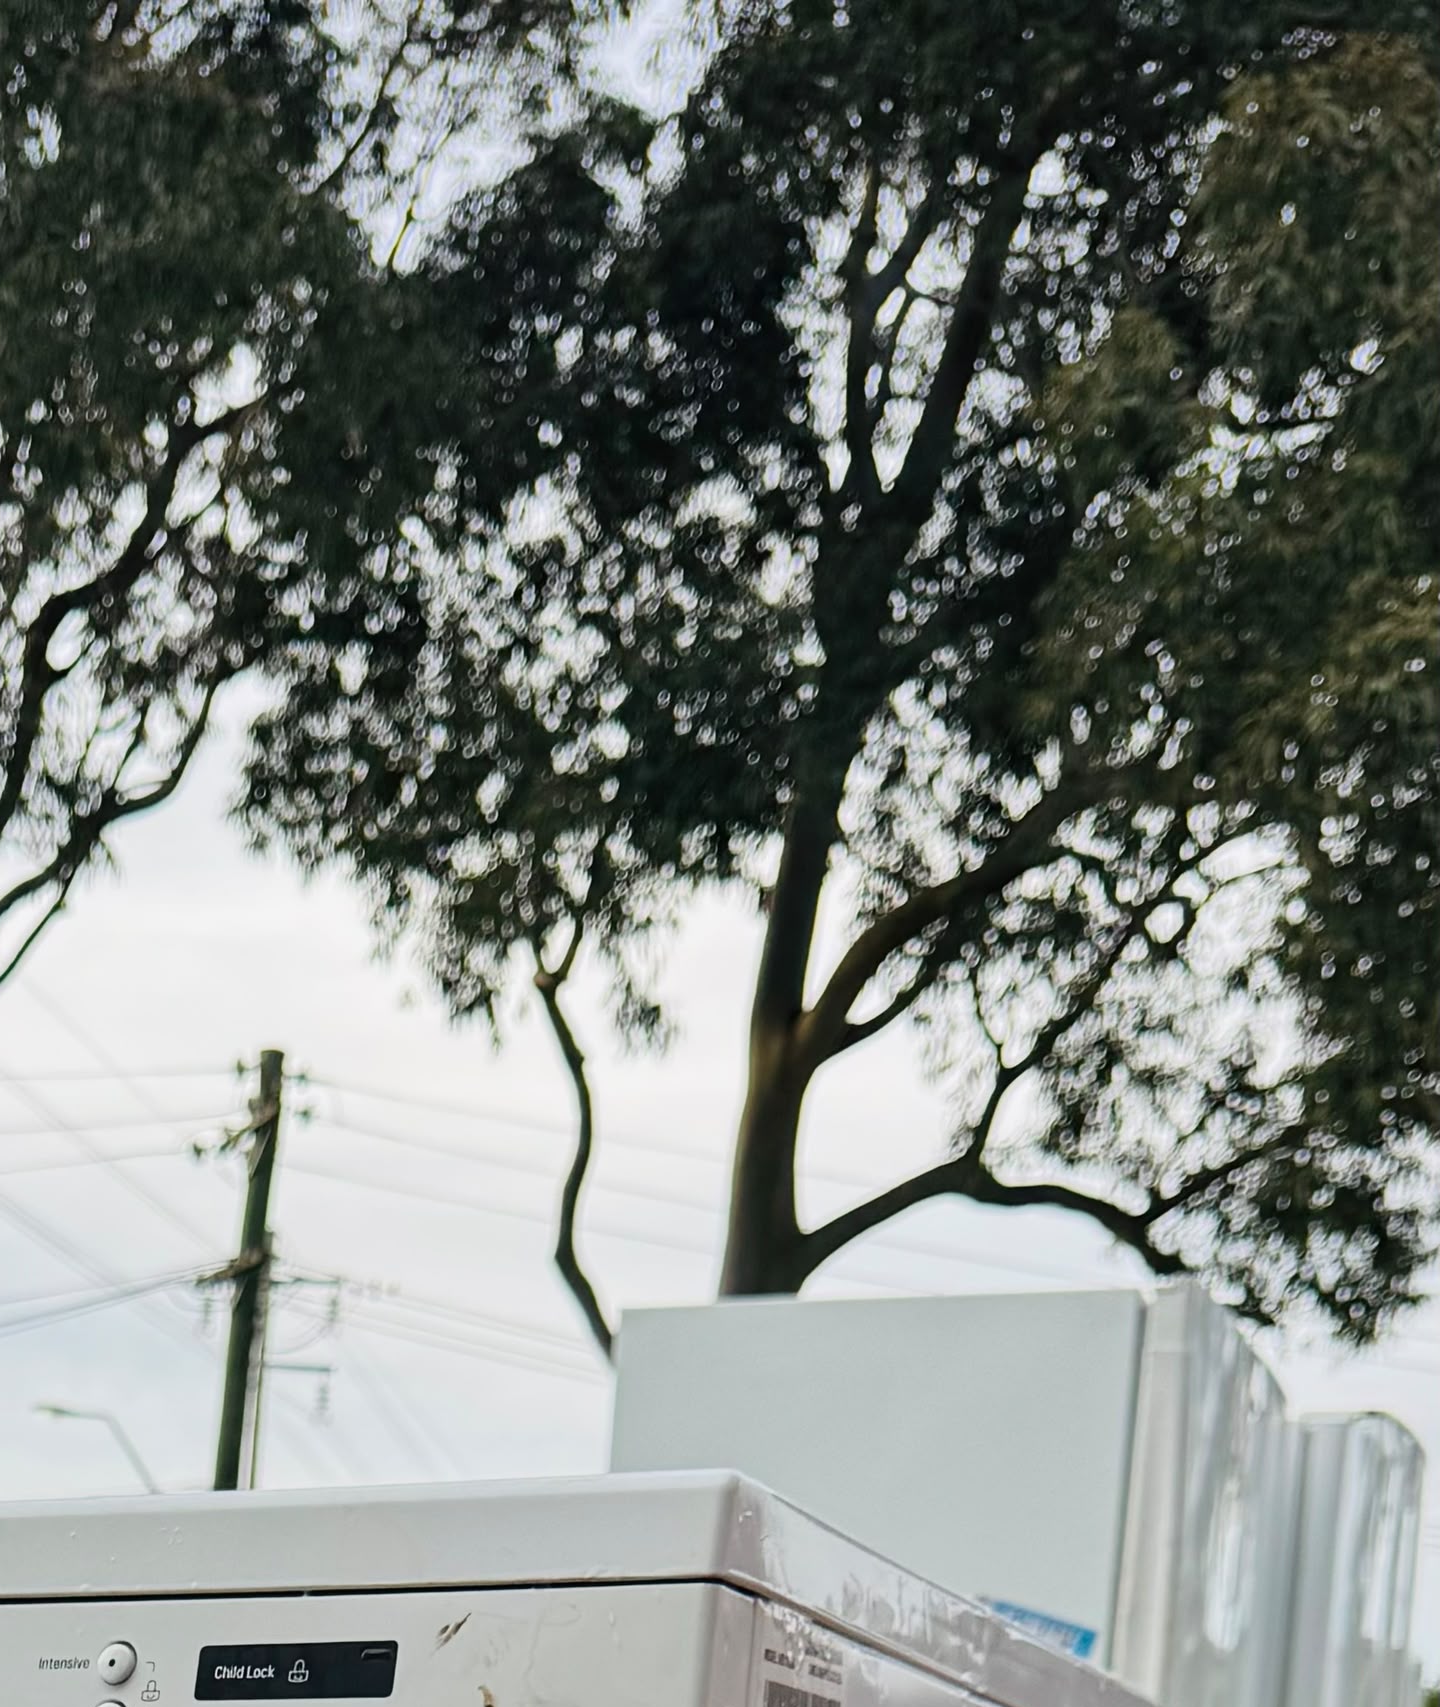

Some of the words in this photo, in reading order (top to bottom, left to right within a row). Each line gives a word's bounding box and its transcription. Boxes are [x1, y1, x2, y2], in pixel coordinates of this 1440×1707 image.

[38, 1657, 90, 1670] Intensive
[214, 1666, 244, 1680] Child
[246, 1665, 275, 1679] Lock
